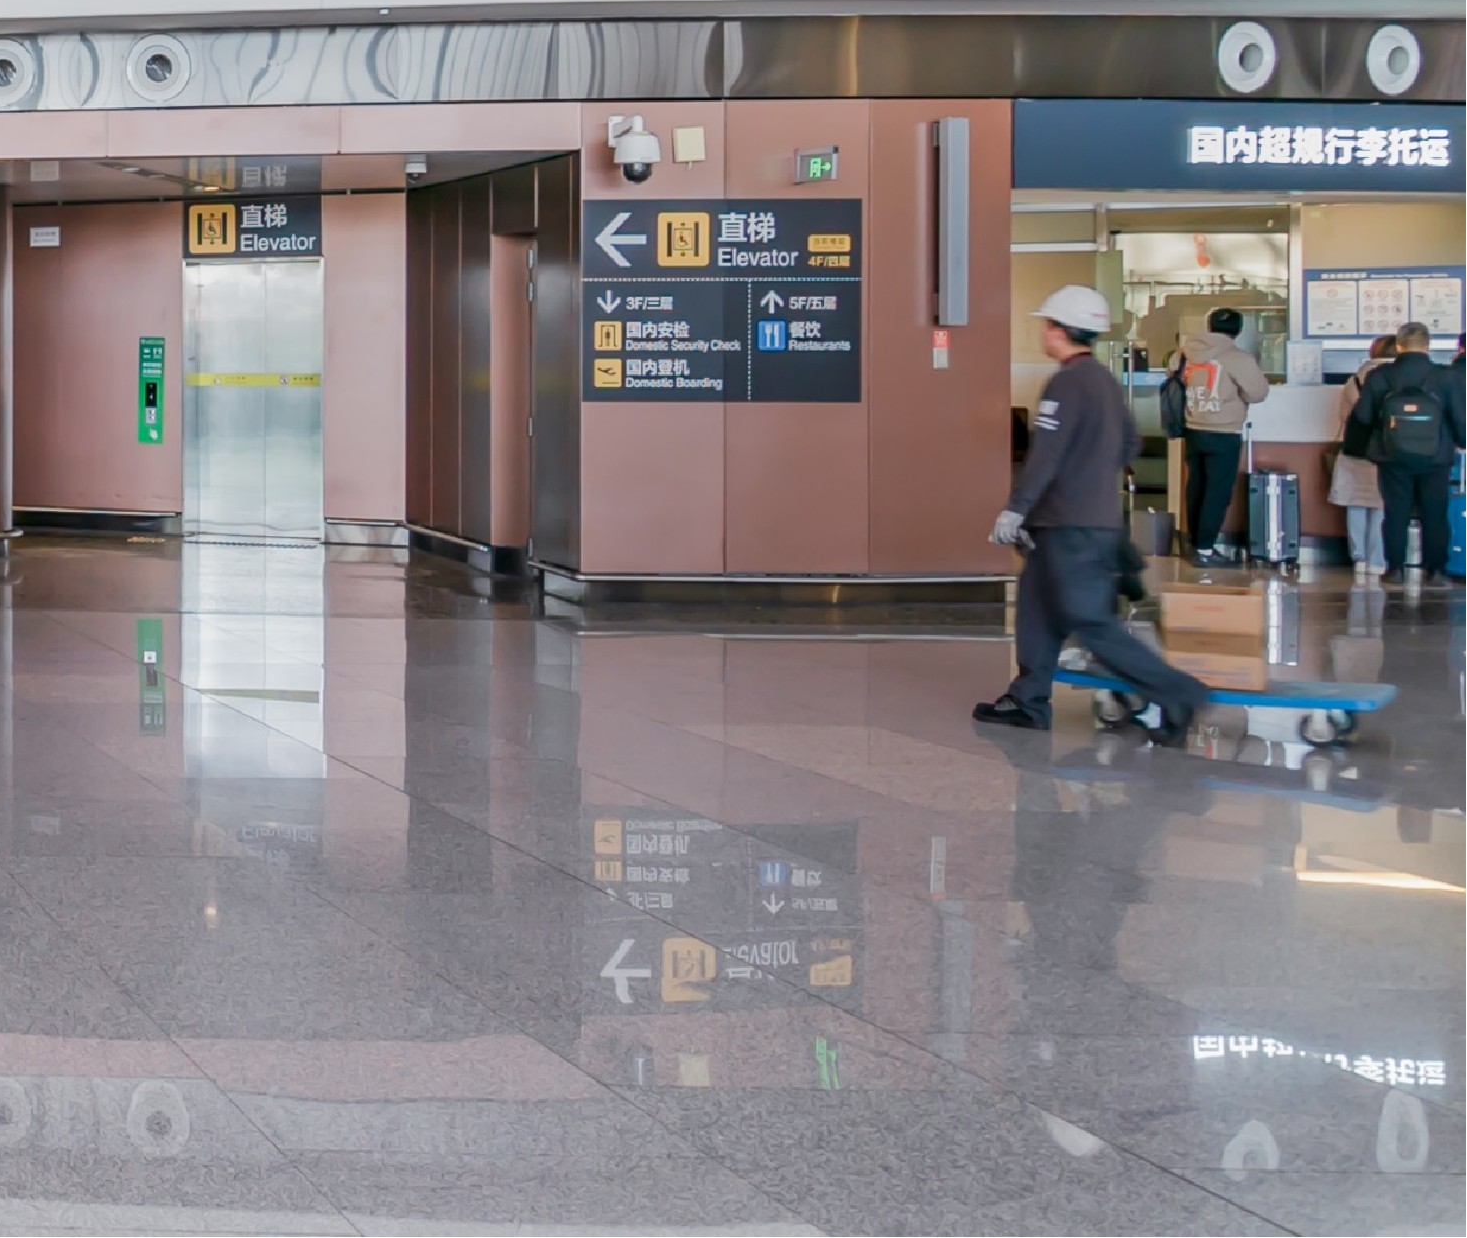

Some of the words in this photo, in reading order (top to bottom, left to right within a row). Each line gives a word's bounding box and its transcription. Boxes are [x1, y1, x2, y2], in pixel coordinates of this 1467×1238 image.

[1191, 126, 1449, 166] 国内超规行李托运
[240, 204, 288, 228] 直梯
[718, 212, 776, 243] 直梯
[240, 234, 317, 252] Elevator
[718, 247, 799, 266] Elevator
[626, 321, 690, 339] 国内安检
[789, 321, 821, 339] 餐饮
[626, 339, 669, 351] Domestic
[670, 339, 710, 353] Security
[711, 339, 741, 351] Check
[789, 340, 851, 351] Restaurants
[626, 359, 691, 376] 国内登机
[626, 377, 674, 388] Domestic
[675, 377, 723, 391] Boarding
